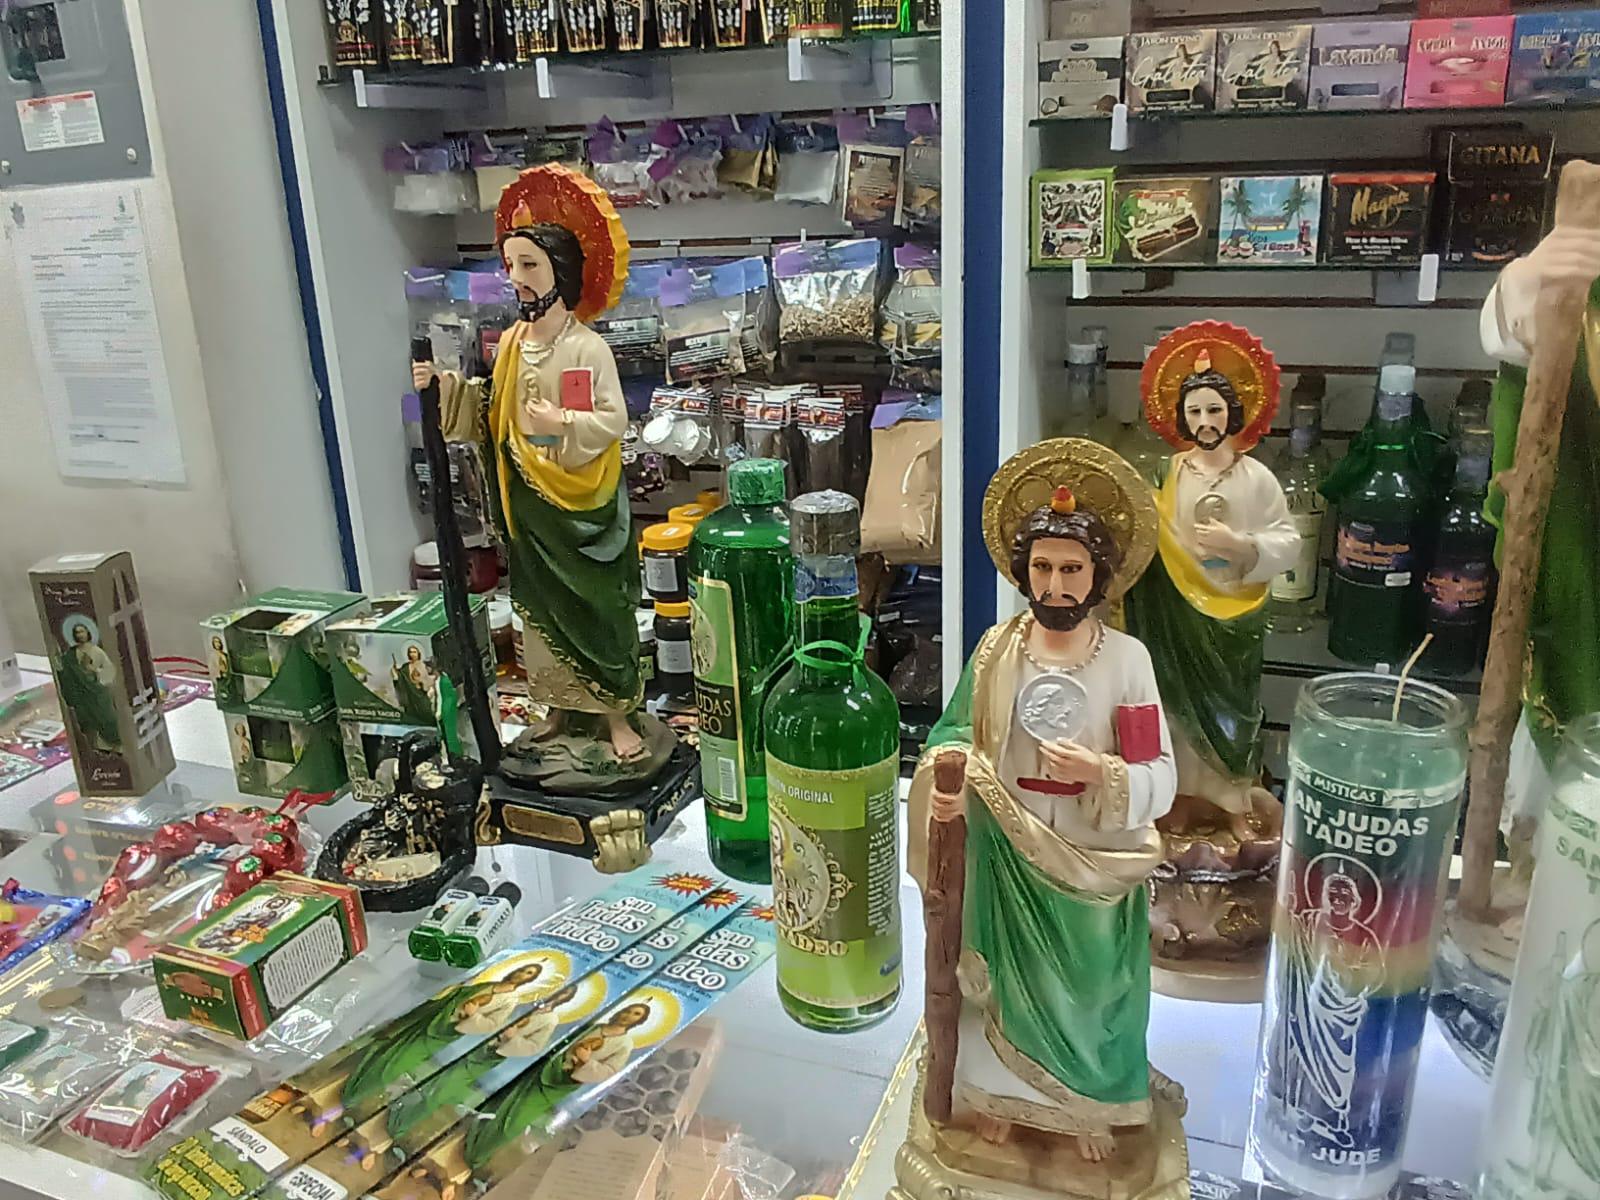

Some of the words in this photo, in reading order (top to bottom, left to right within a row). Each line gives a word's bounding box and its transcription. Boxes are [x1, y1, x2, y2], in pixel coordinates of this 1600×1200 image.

[1319, 43, 1398, 66] Lavanda
[1461, 145, 1541, 164] GITANA
[695, 693, 732, 717] UDAS
[787, 785, 835, 804] ORIGINAL
[1314, 776, 1378, 803] MISTICAS
[1296, 788, 1322, 819] AN
[1329, 809, 1430, 837] JUDAS
[1303, 815, 1399, 856] TADEO
[690, 943, 750, 971] das
[666, 960, 726, 990] deo
[1311, 1146, 1382, 1167] JUDE
